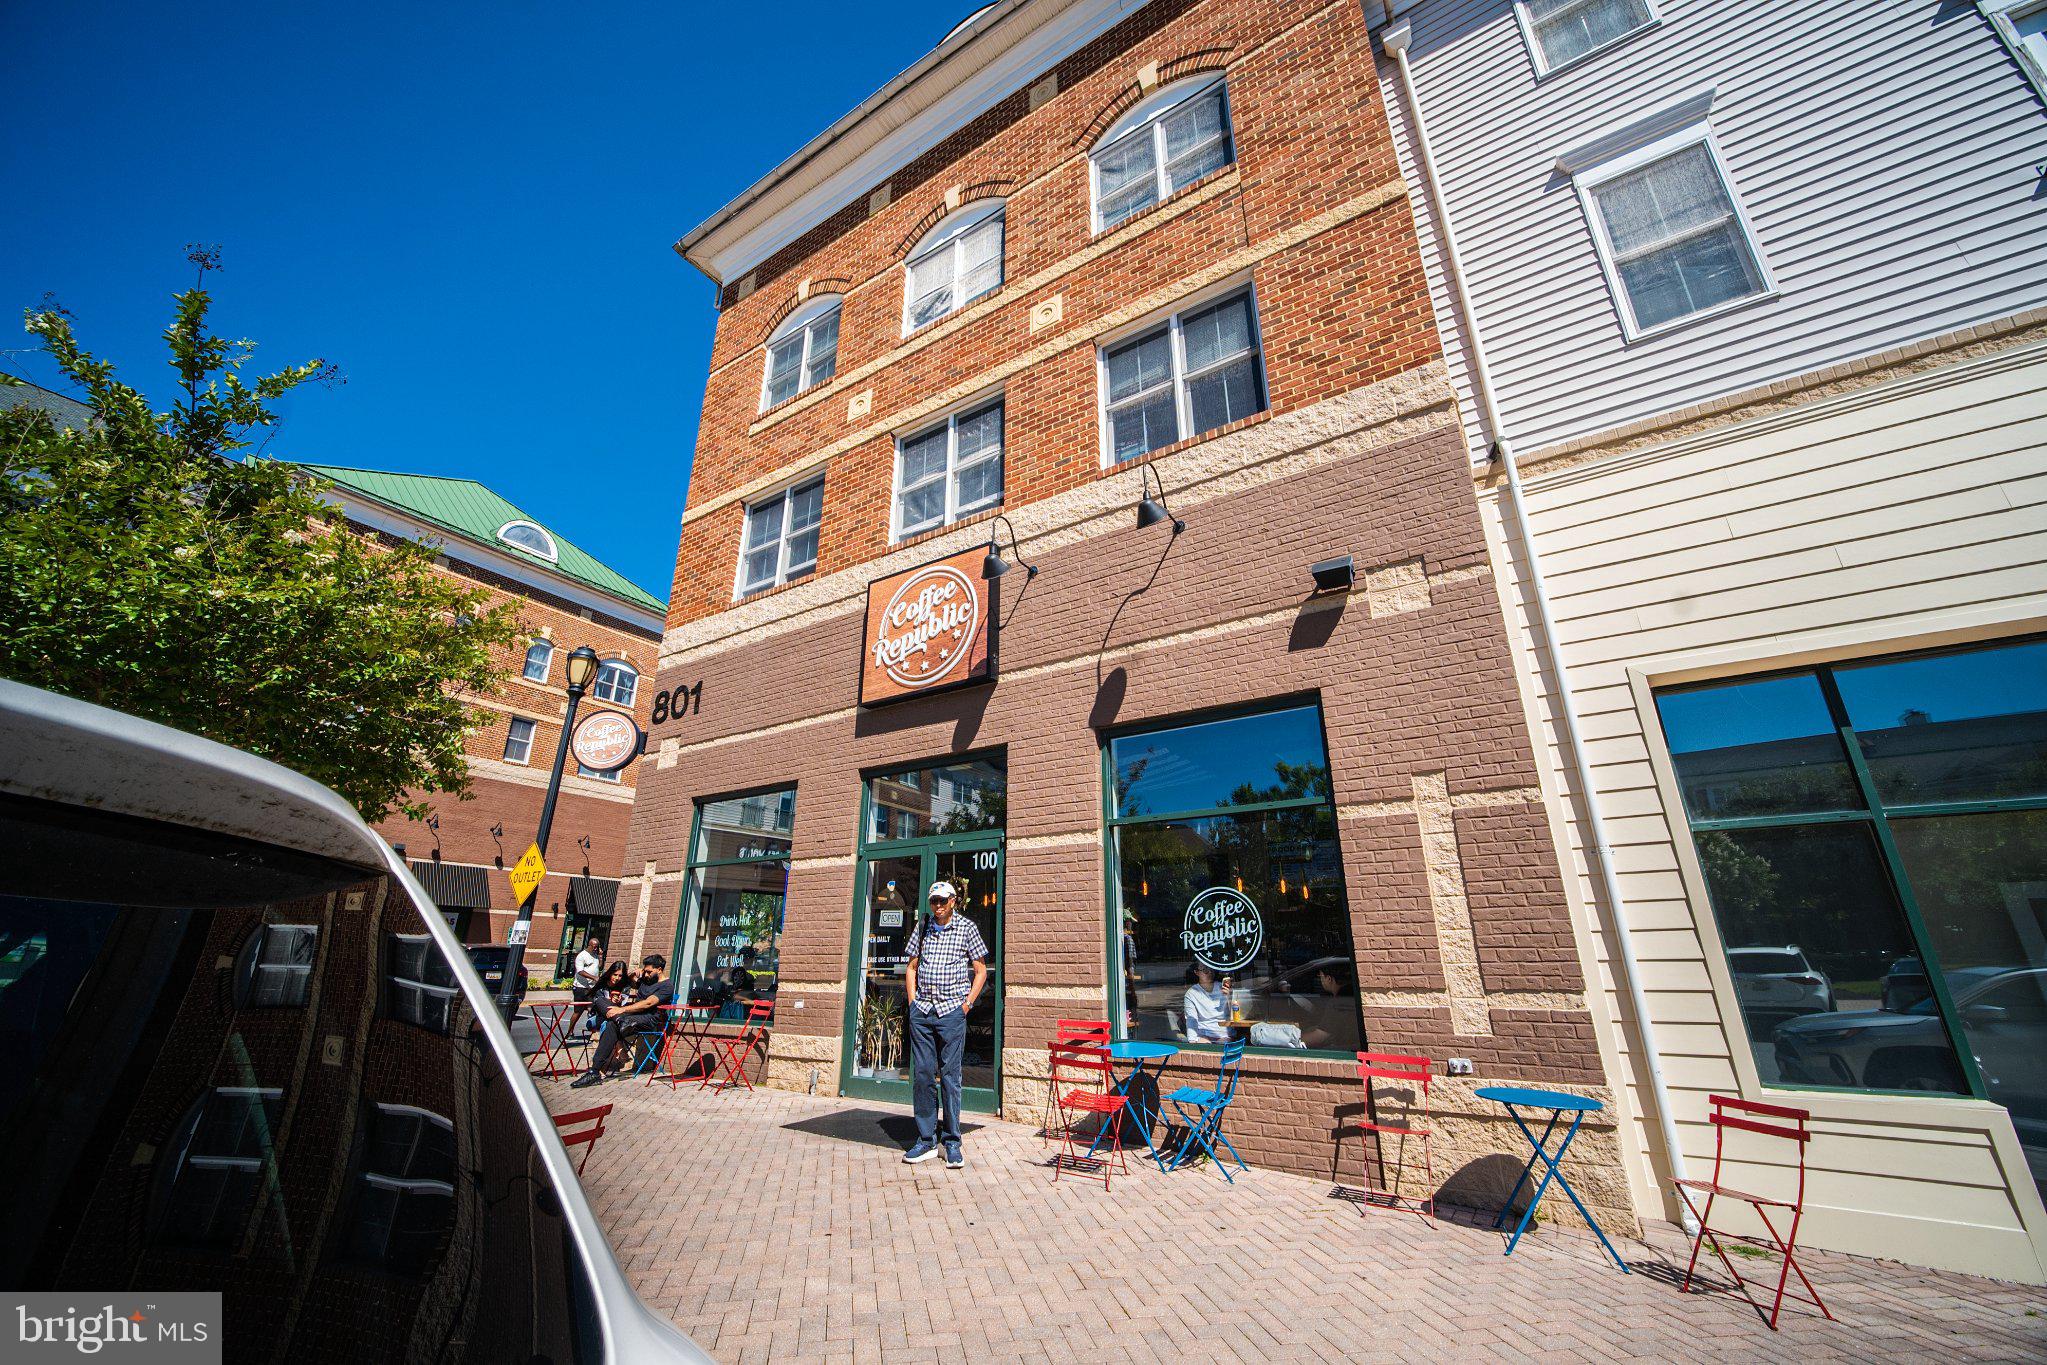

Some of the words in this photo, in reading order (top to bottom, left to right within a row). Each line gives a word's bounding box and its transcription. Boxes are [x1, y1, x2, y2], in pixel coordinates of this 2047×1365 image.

[889, 580, 959, 627] Coffee
[872, 602, 974, 668] Republic
[652, 680, 703, 725] 801
[585, 723, 623, 739] Coffee
[575, 734, 629, 753] Republic
[524, 856, 536, 867] NO
[972, 851, 998, 870] 100
[513, 870, 541, 884] OUTLET
[719, 914, 738, 927] Drink
[738, 913, 752, 926] Hot
[882, 914, 900, 923] OPEN
[1191, 899, 1245, 928] Coffee
[877, 935, 891, 943] DAILY
[1180, 917, 1259, 951] Republic
[716, 954, 729, 967] Eat
[730, 954, 745, 967] Well
